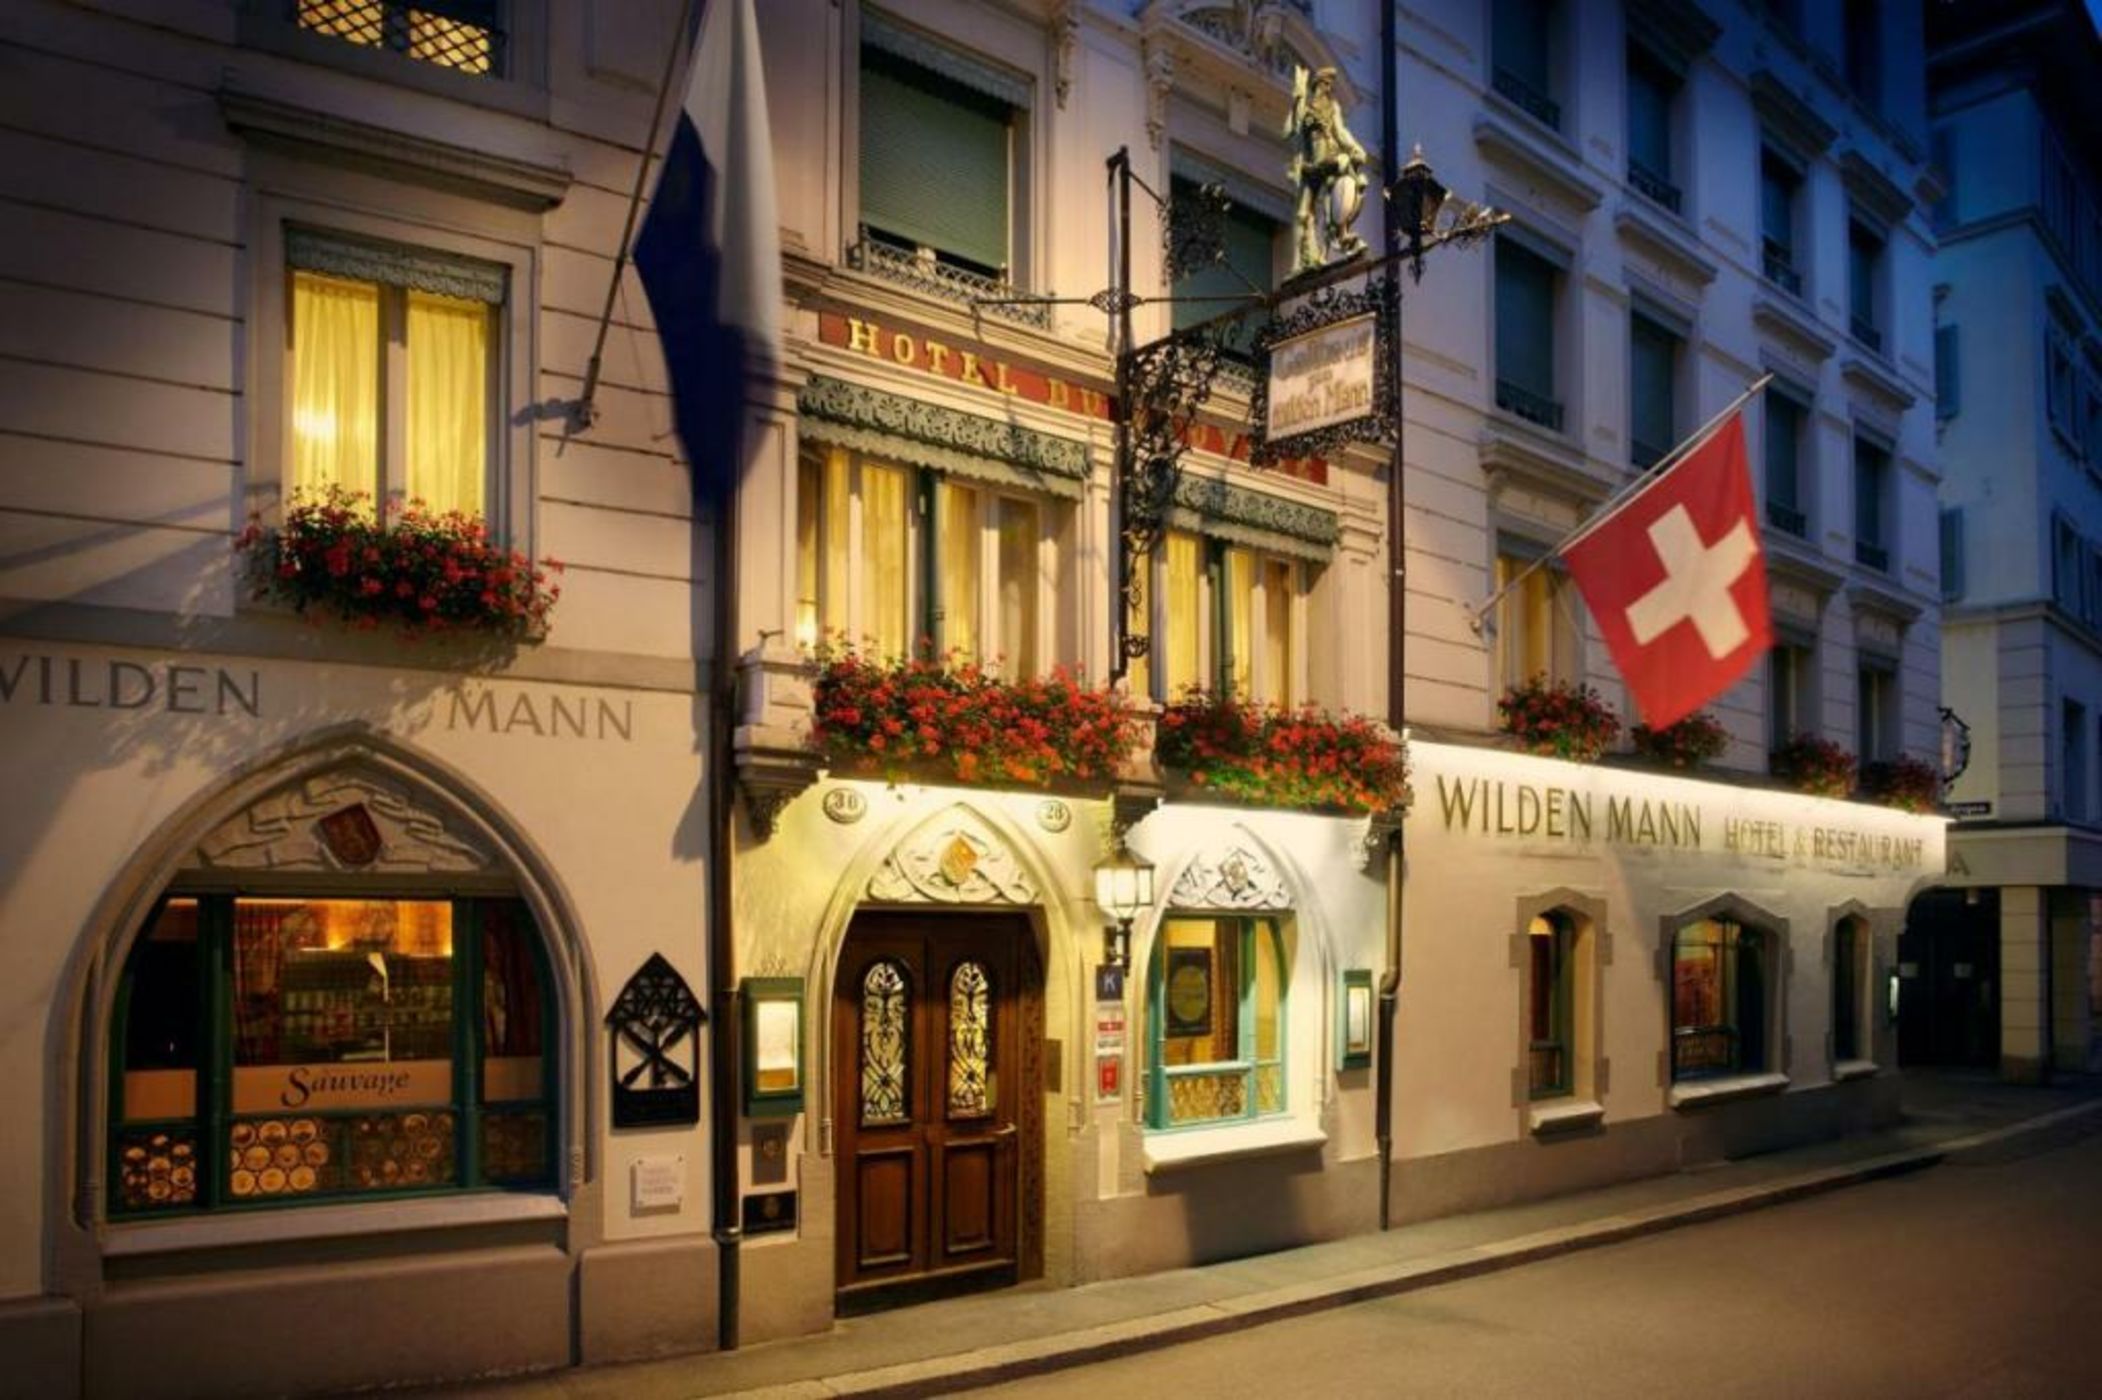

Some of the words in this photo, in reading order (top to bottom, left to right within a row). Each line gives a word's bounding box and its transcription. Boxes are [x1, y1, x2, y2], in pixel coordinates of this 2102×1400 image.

[848, 318, 1018, 396] HOTEL
[448, 688, 632, 741] MANN
[1437, 774, 1591, 839] WILDEN
[1606, 794, 1701, 847] MANN
[1723, 816, 1787, 856] HOTEL
[1813, 827, 1924, 866] RESTAURANT
[1103, 972, 1116, 992] K
[281, 1067, 410, 1108] Sauvage
